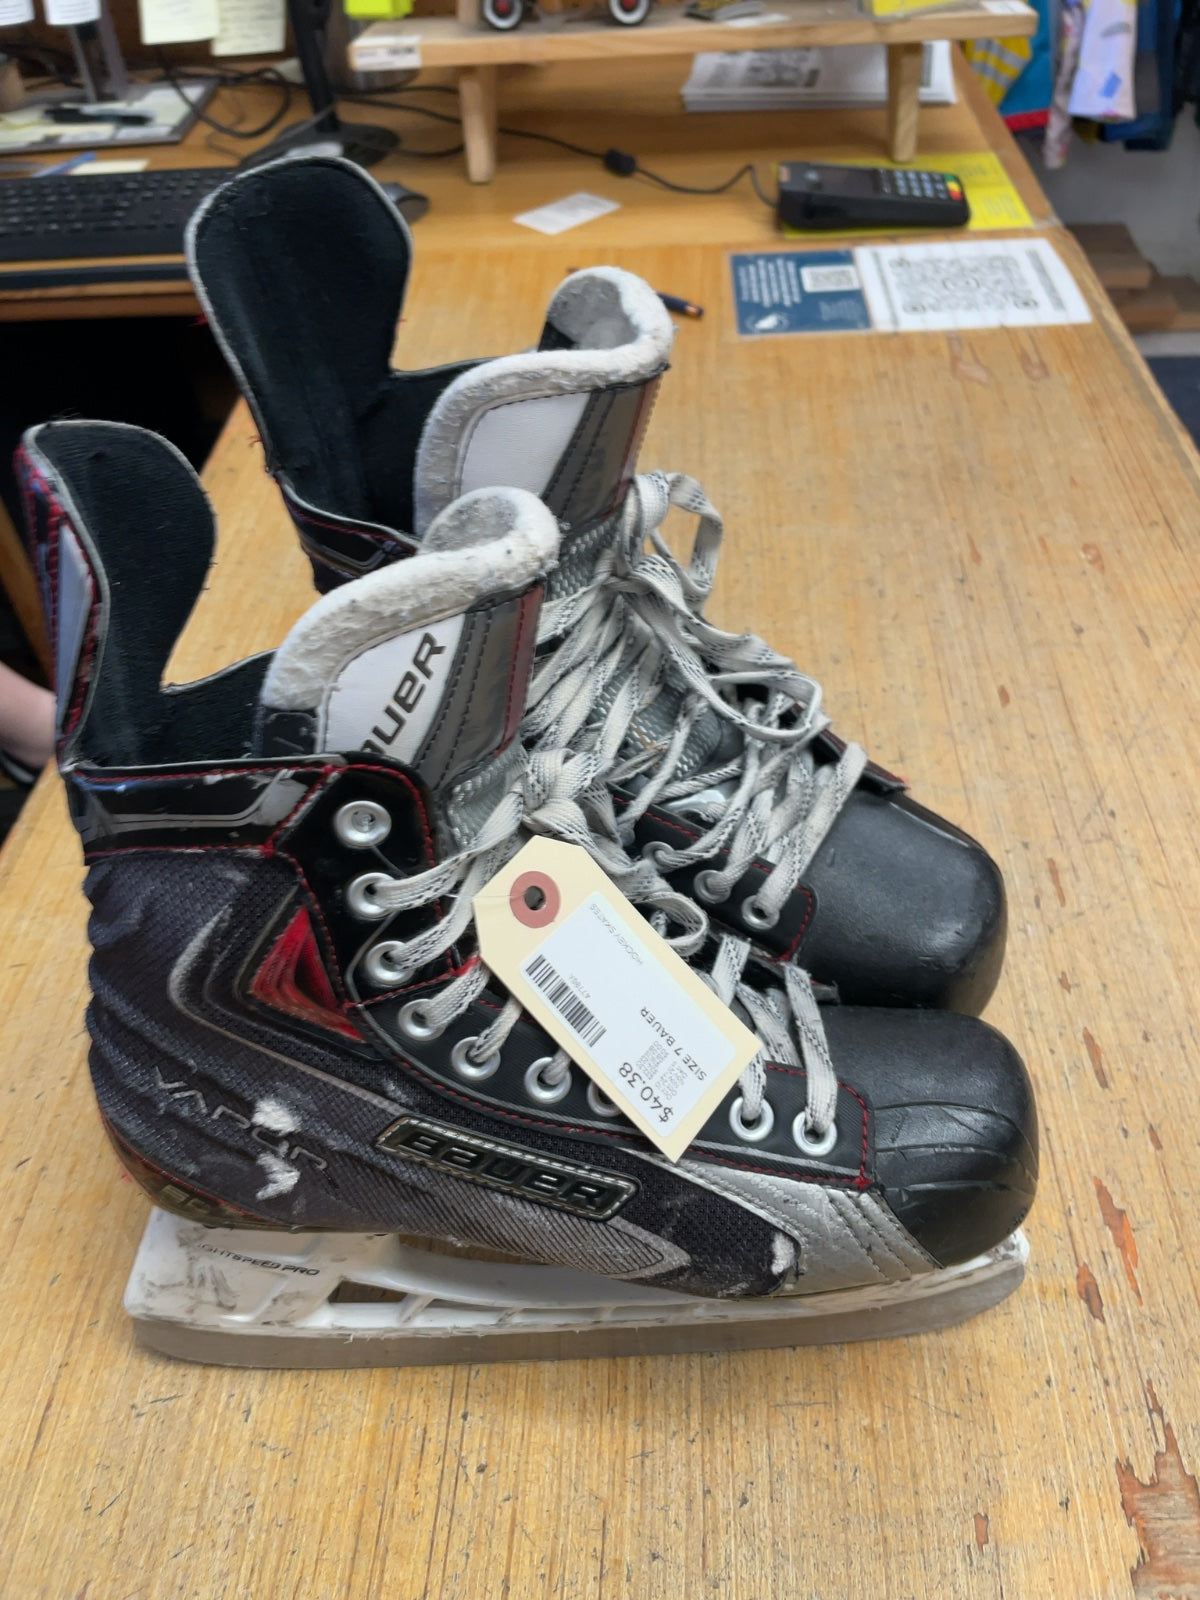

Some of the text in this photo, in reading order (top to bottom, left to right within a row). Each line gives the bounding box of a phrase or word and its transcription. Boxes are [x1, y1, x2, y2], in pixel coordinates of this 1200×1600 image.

[360, 632, 446, 752] UER
[588, 902, 643, 965] HOCKEY SKATES
[638, 1006, 675, 1046] BAUER
[616, 1060, 676, 1124] $40.38
[681, 1053, 707, 1082] SIZE
[398, 1128, 608, 1212] BAUER
[281, 1264, 321, 1277] PRO
